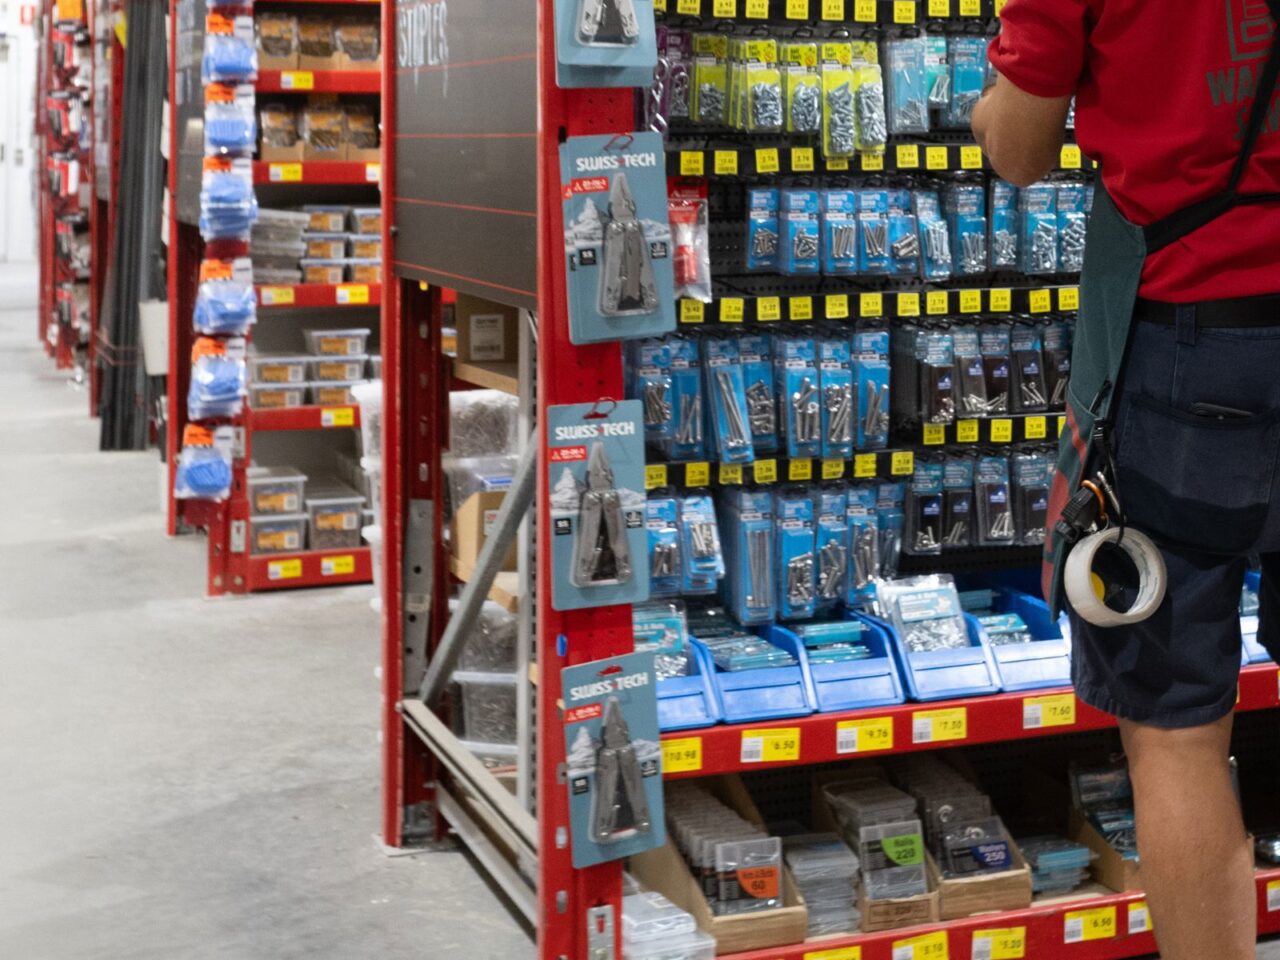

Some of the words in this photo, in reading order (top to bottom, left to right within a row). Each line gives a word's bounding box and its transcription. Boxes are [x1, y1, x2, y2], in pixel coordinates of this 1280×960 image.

[575, 155, 619, 172] SWISS
[624, 152, 656, 168] TECH
[555, 424, 598, 441] SWISS
[602, 421, 635, 437] TECH
[570, 680, 613, 701] SWISS
[616, 672, 649, 691] TECH
